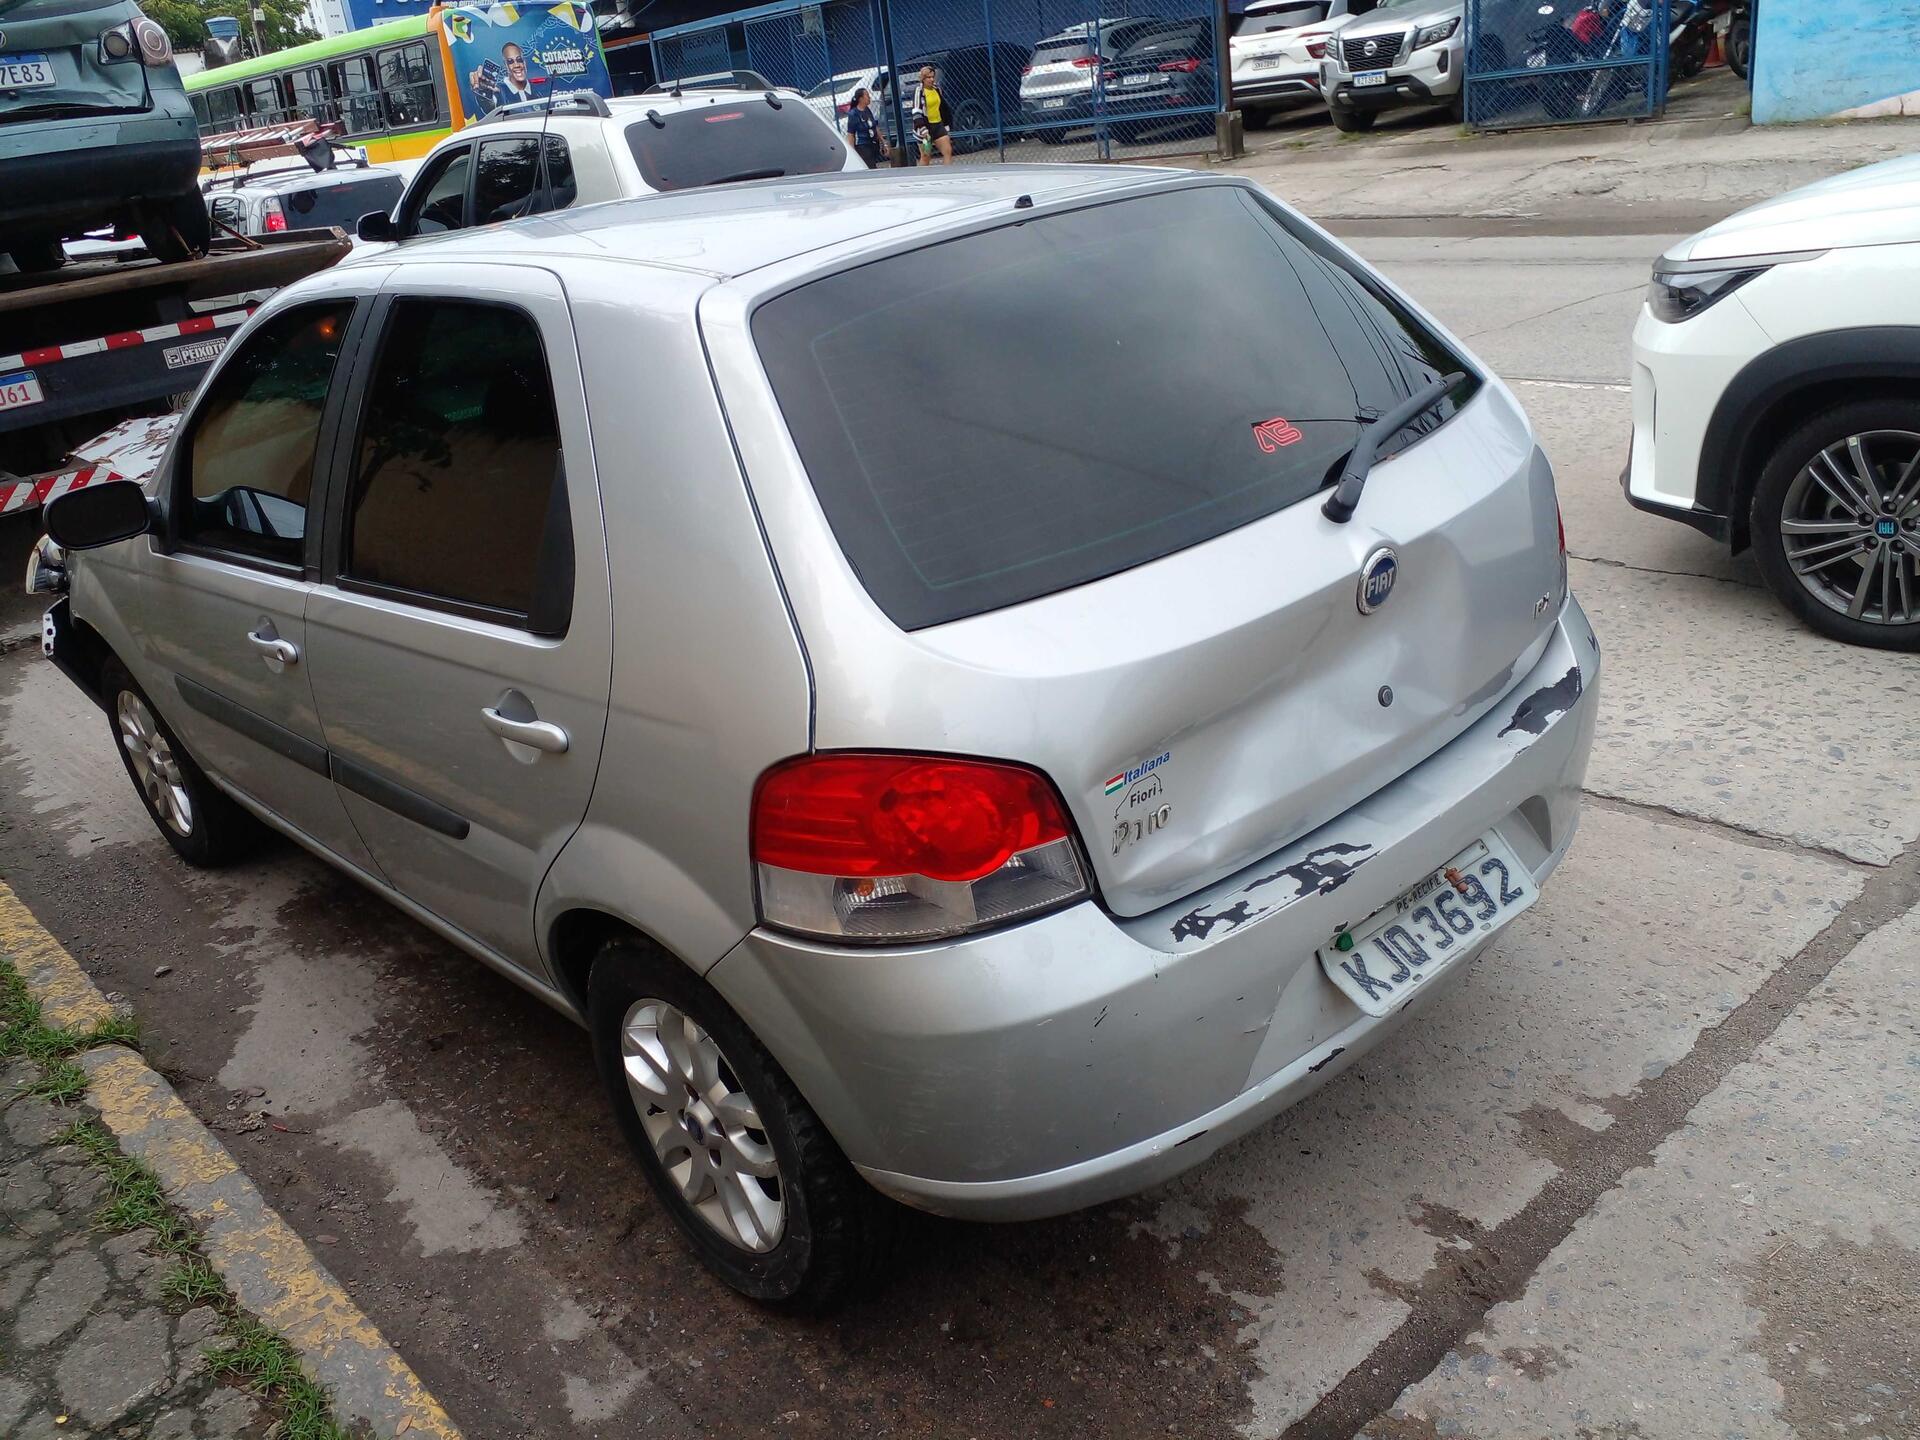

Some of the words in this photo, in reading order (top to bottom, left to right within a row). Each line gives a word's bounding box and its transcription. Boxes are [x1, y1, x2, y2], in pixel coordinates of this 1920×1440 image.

[542, 48, 583, 63] COTAÇÕES
[1878, 522, 1895, 535] FIAT
[1367, 567, 1396, 599] FIAT
[1124, 751, 1170, 786] Italiana
[1130, 783, 1157, 808] Fiori
